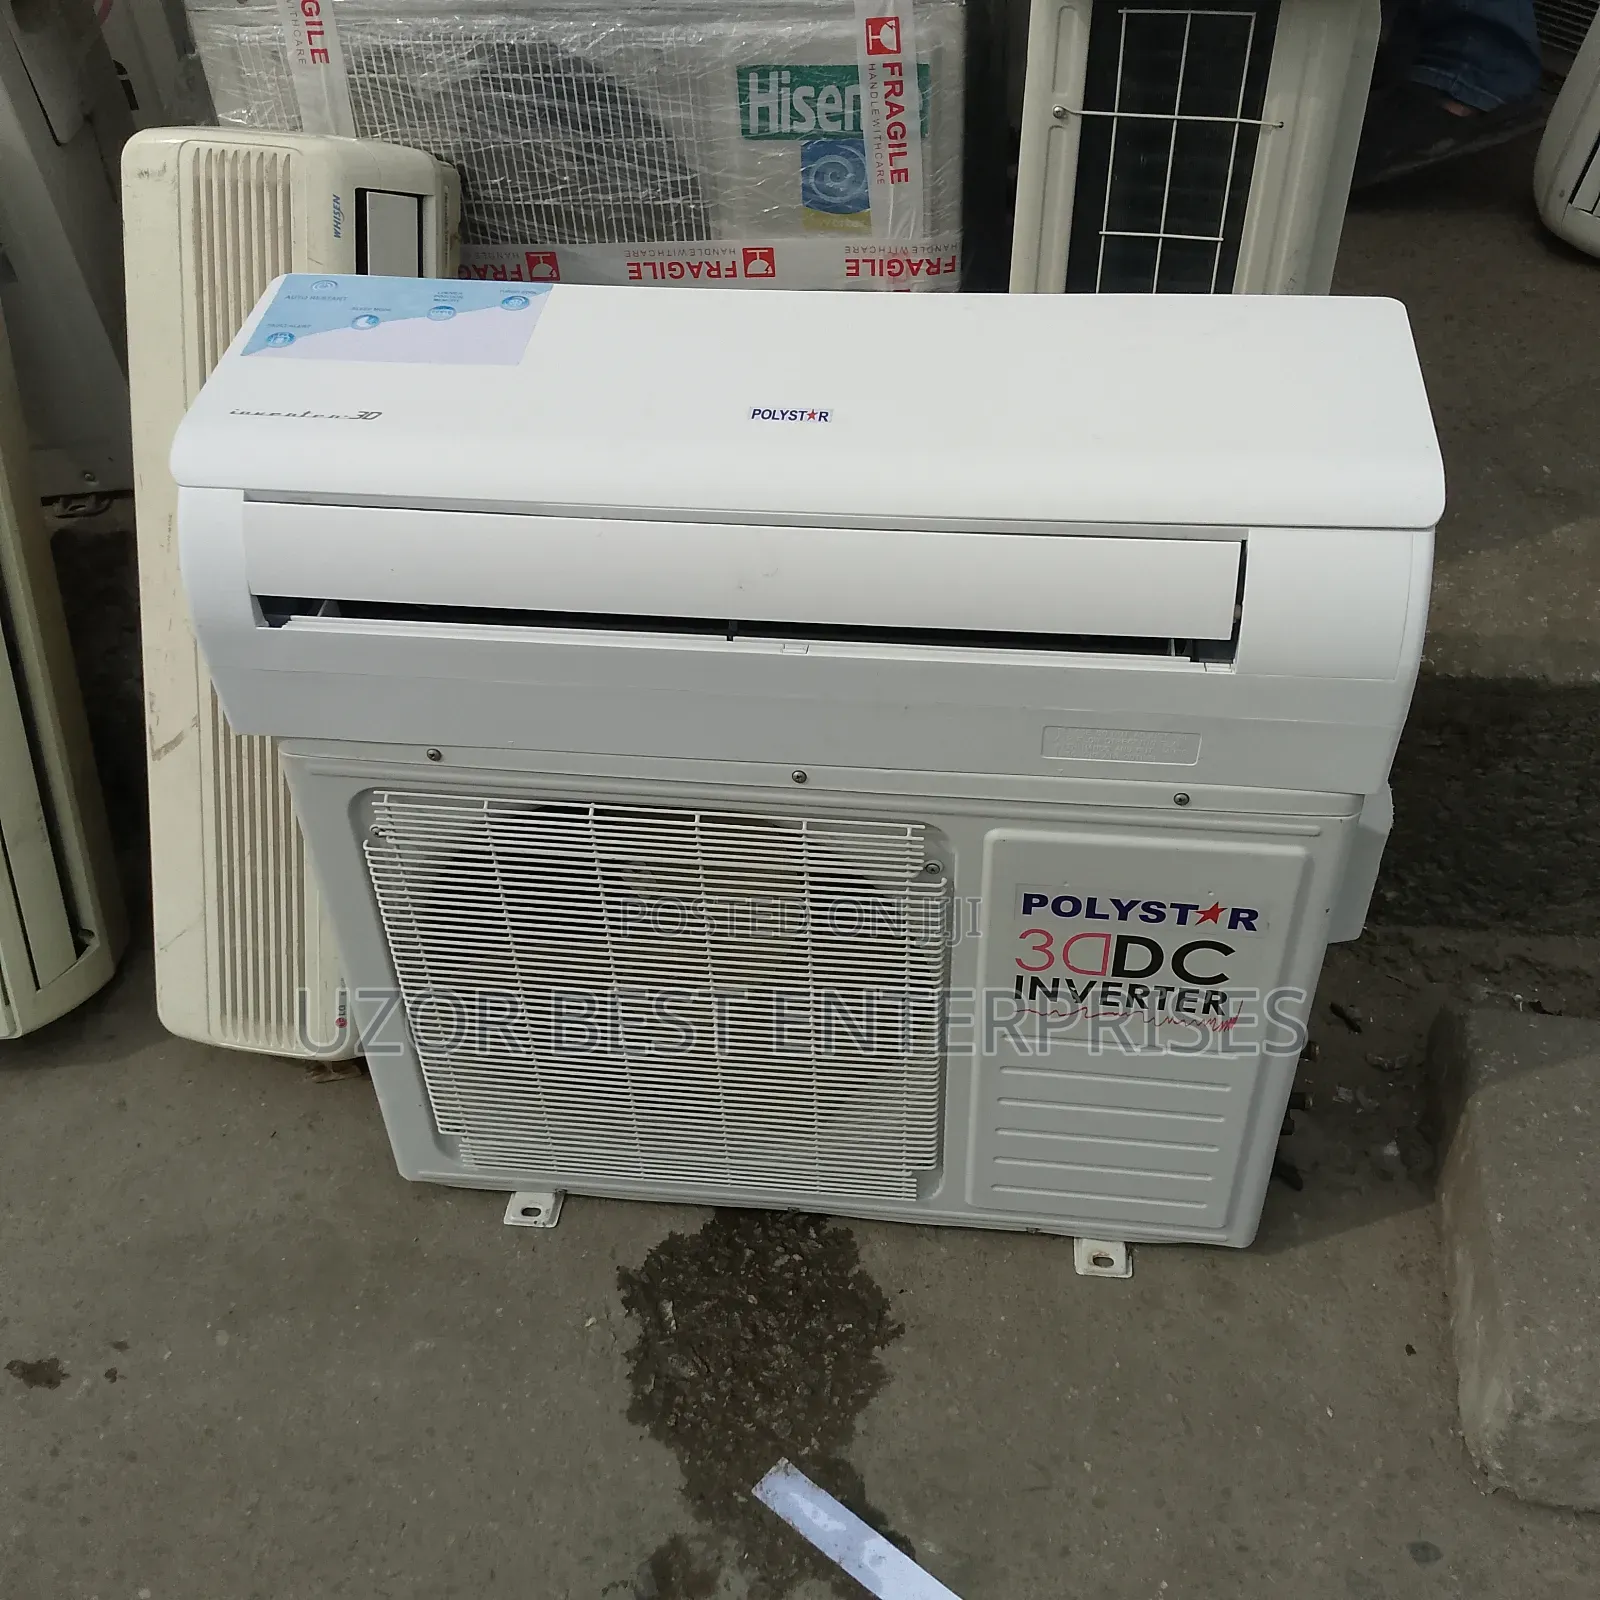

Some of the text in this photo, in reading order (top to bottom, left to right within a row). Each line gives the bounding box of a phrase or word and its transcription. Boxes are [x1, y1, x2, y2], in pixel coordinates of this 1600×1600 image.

[301, 0, 330, 64] GILE
[748, 70, 863, 135] Hisen
[882, 61, 909, 185] FRAGILE
[332, 193, 342, 239] WHISEN
[457, 263, 525, 282] FRAG
[626, 260, 738, 281] FRAGILE
[845, 255, 957, 278] FRAGILE
[1013, 974, 1230, 1017] INVERTER
